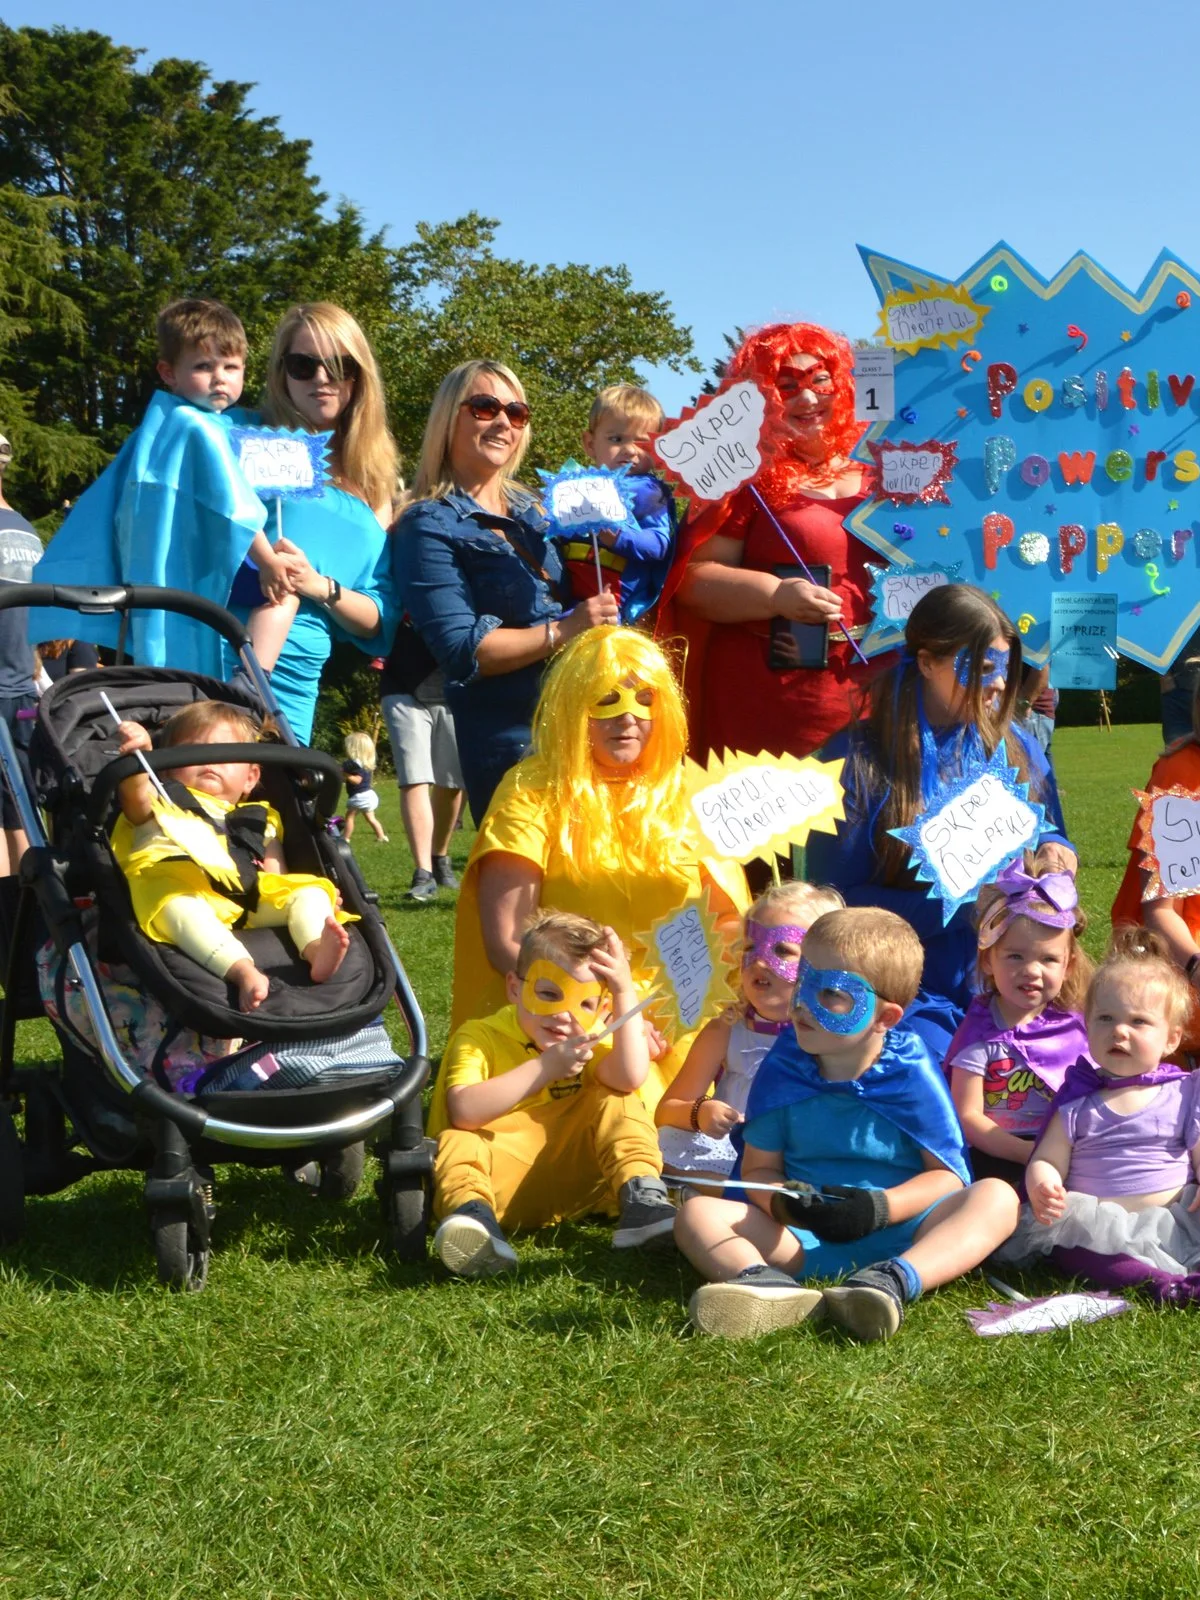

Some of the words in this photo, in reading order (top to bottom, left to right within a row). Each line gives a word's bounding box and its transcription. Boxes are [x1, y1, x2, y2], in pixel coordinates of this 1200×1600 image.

[865, 387, 880, 410] 1
[695, 441, 755, 494] loving
[984, 436, 1200, 494] Powers
[3, 548, 41, 564] SALTRO
[1074, 625, 1107, 638] PRIZE
